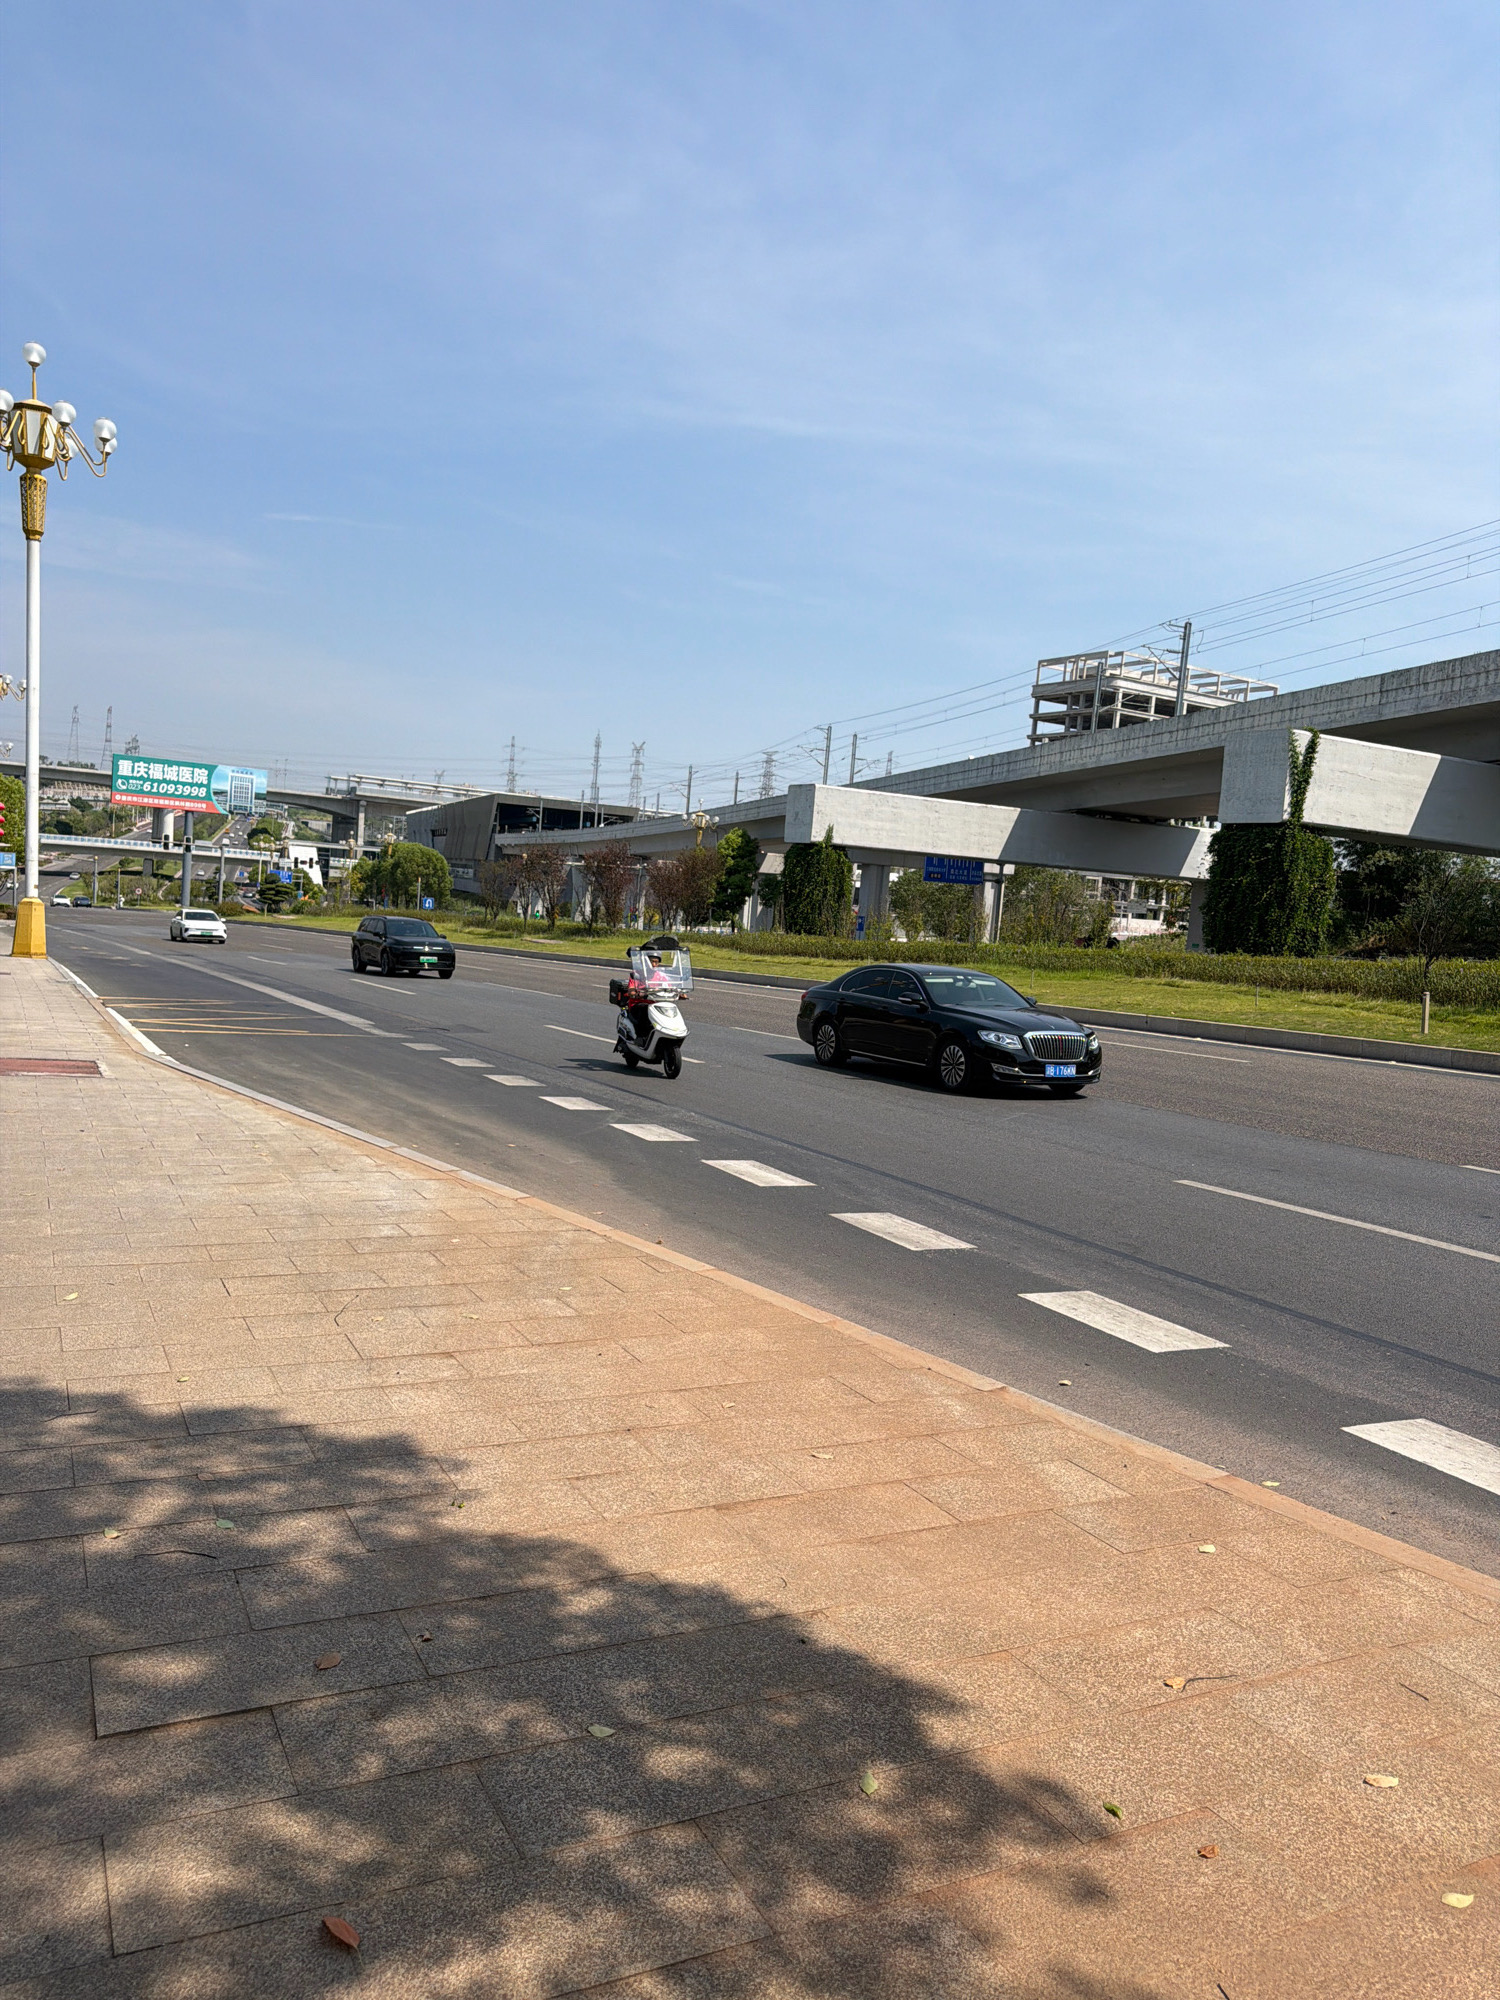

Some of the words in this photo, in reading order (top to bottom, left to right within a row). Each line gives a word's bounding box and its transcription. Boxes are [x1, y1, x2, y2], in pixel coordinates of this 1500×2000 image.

[117, 760, 209, 784] 重庆福城医院
